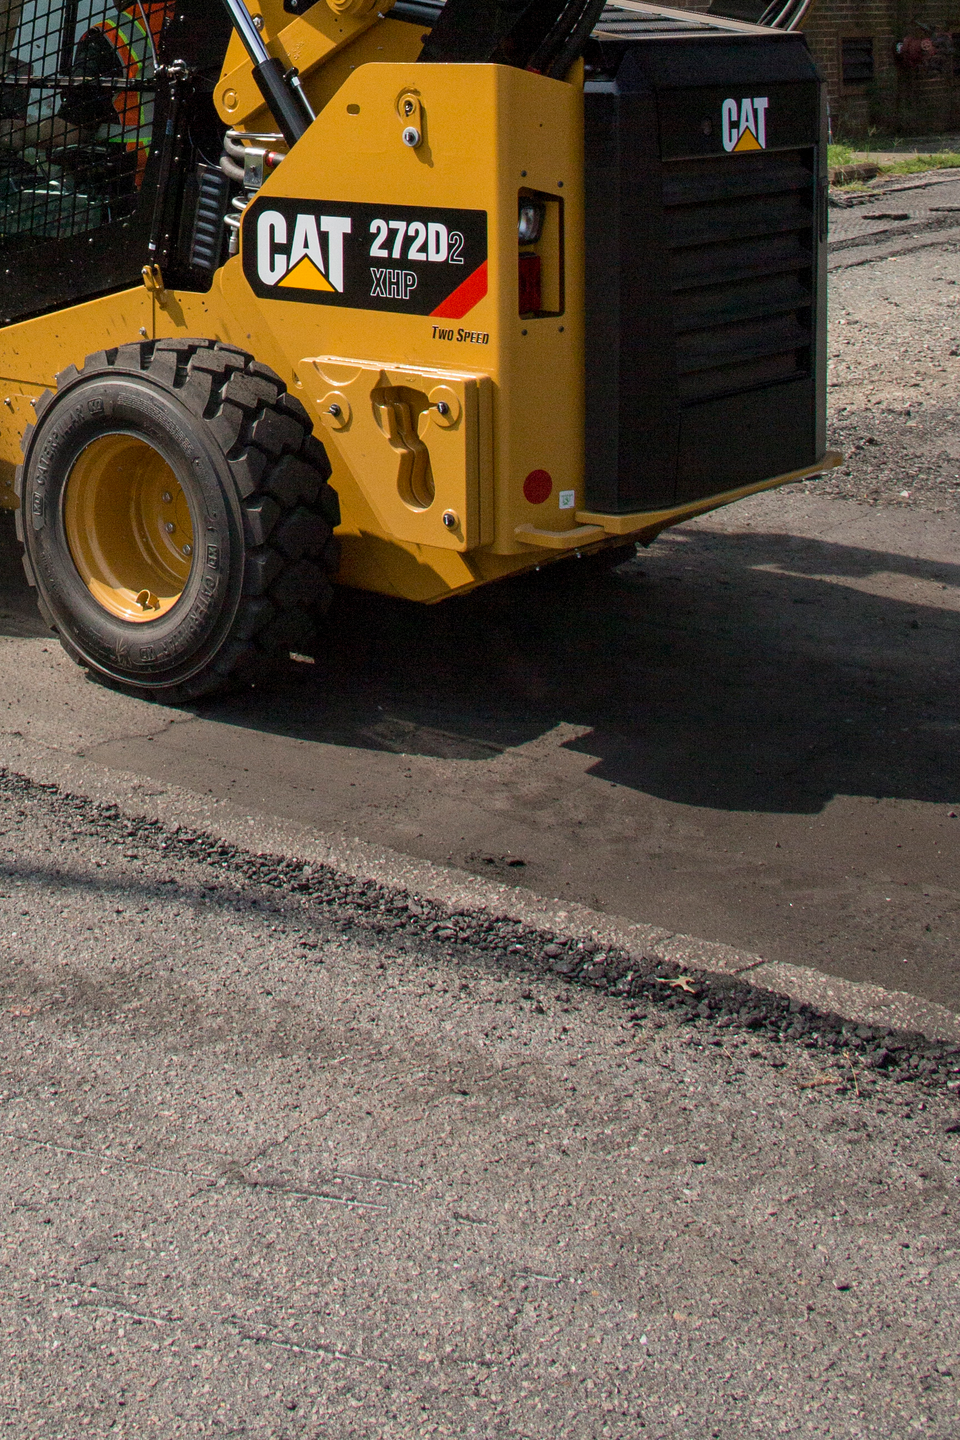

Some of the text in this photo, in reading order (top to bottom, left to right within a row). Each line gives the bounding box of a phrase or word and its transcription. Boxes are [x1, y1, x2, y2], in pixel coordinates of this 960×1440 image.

[722, 97, 769, 152] CAT
[256, 210, 352, 293] CAT
[369, 218, 465, 265] 272D2
[369, 267, 418, 300] XHP
[36, 403, 84, 486] CATERPILLAR
